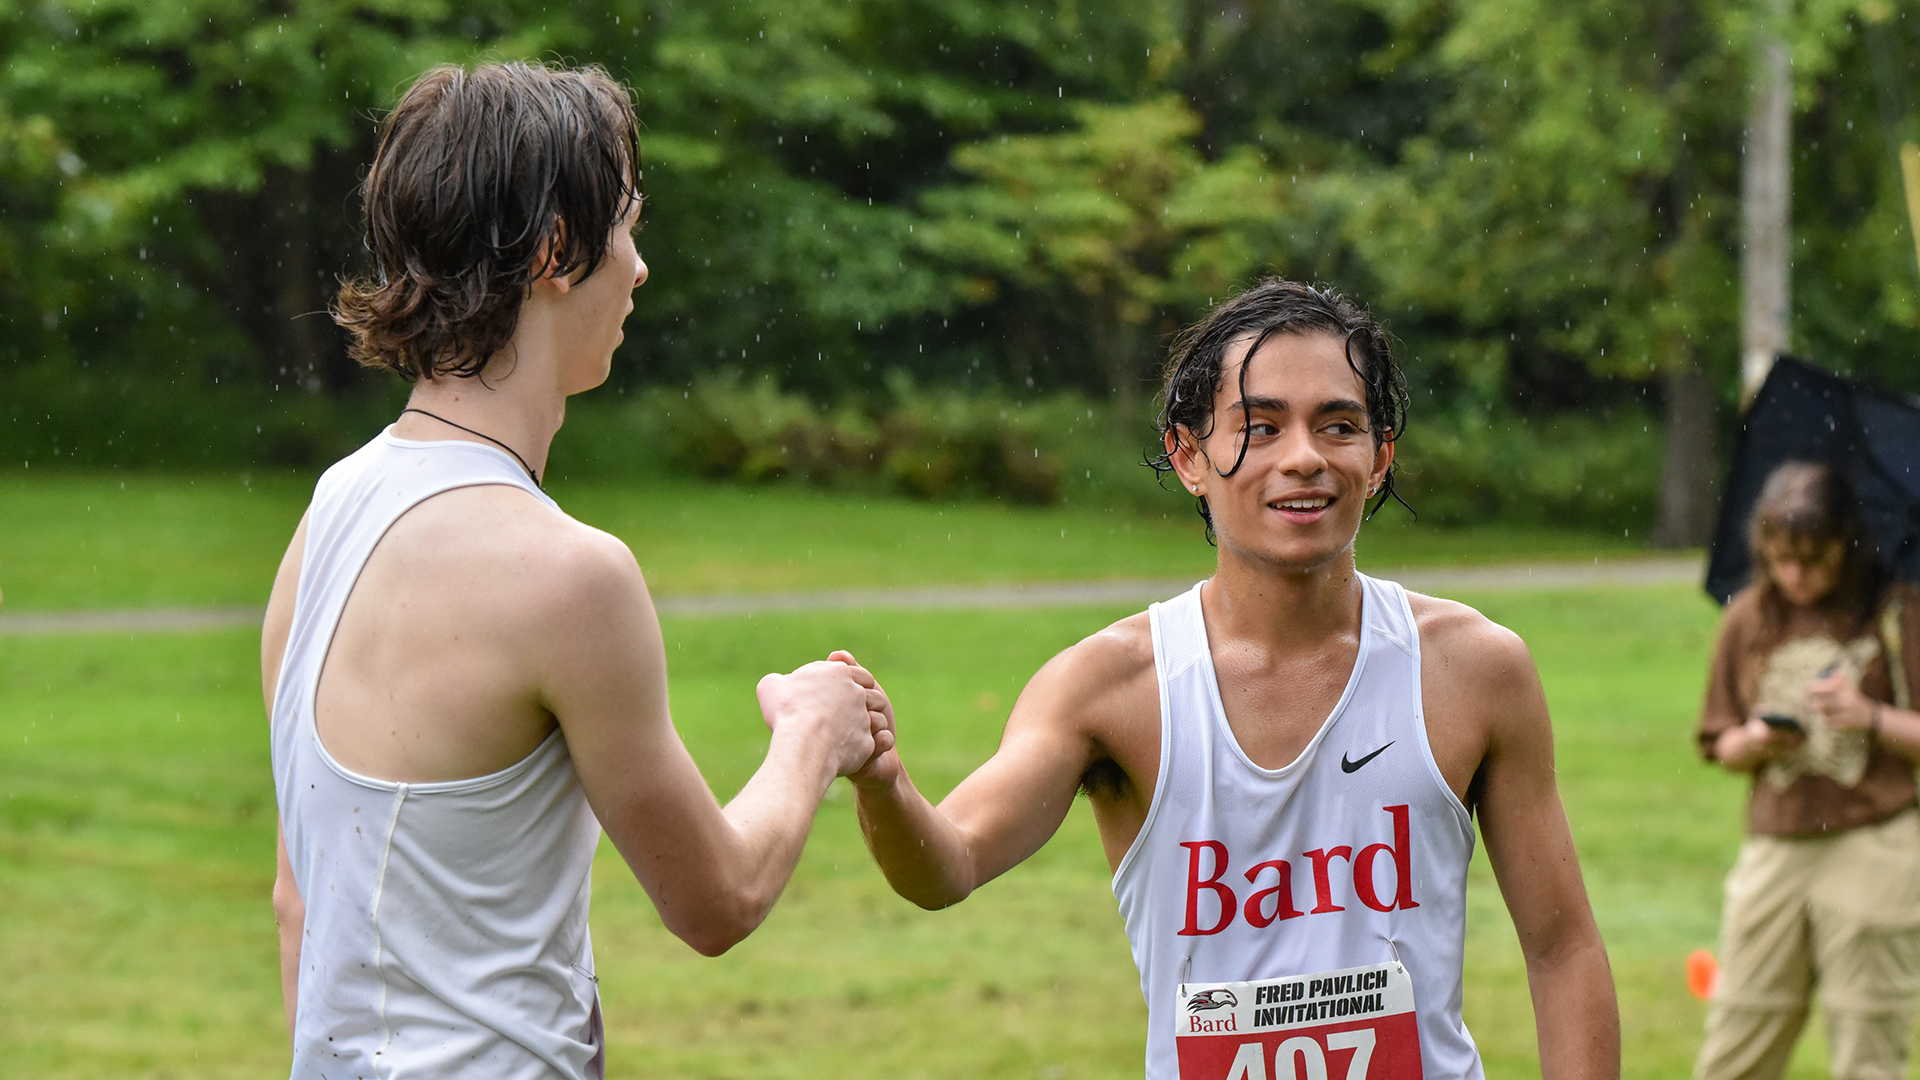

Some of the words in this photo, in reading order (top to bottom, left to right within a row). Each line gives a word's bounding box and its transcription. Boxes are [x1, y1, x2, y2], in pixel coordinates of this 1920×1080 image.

[1177, 804, 1420, 936] Bard
[1255, 981, 1304, 1005] FRED
[1308, 969, 1388, 999] PAVLICH
[1189, 1012, 1238, 1033] Bard
[1253, 992, 1385, 1028] INVITATIONAL
